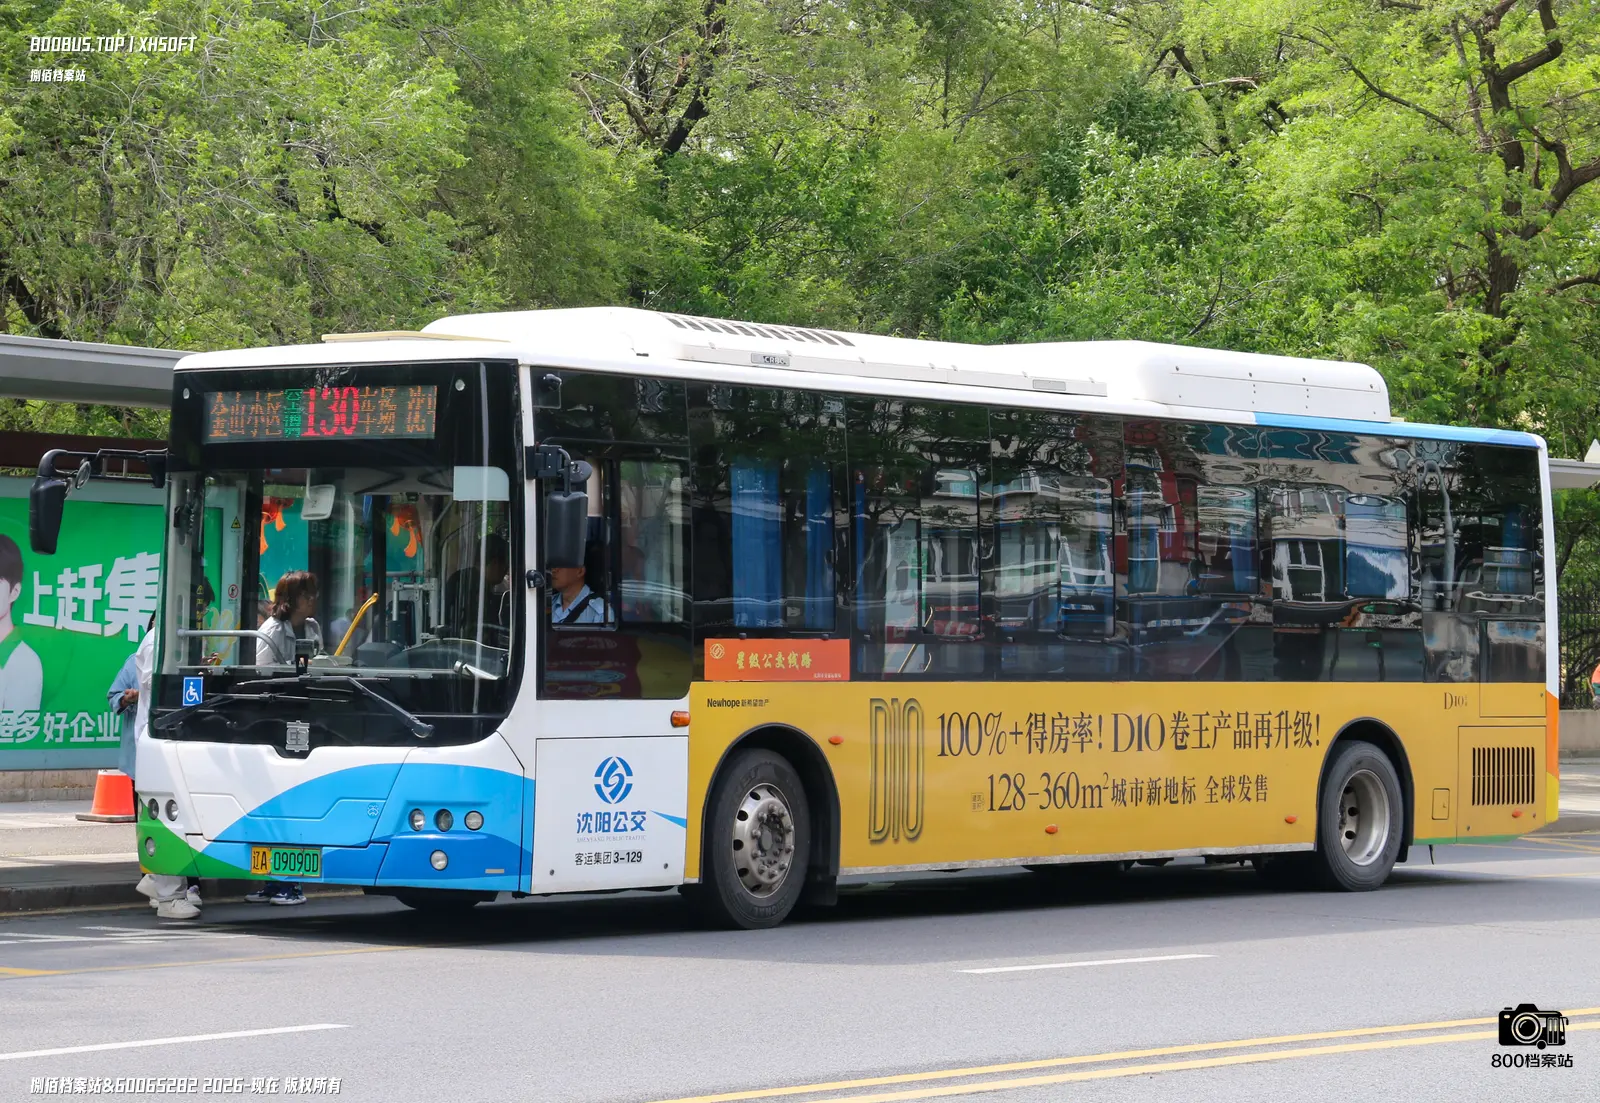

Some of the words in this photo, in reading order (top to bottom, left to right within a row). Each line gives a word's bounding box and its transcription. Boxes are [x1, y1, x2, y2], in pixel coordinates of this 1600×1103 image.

[301, 386, 360, 437] 130
[23, 551, 160, 642] 上赶集
[707, 697, 740, 708] Newhope
[1204, 774, 1268, 804] 全球发售
[576, 810, 647, 834] 沈阳公交
